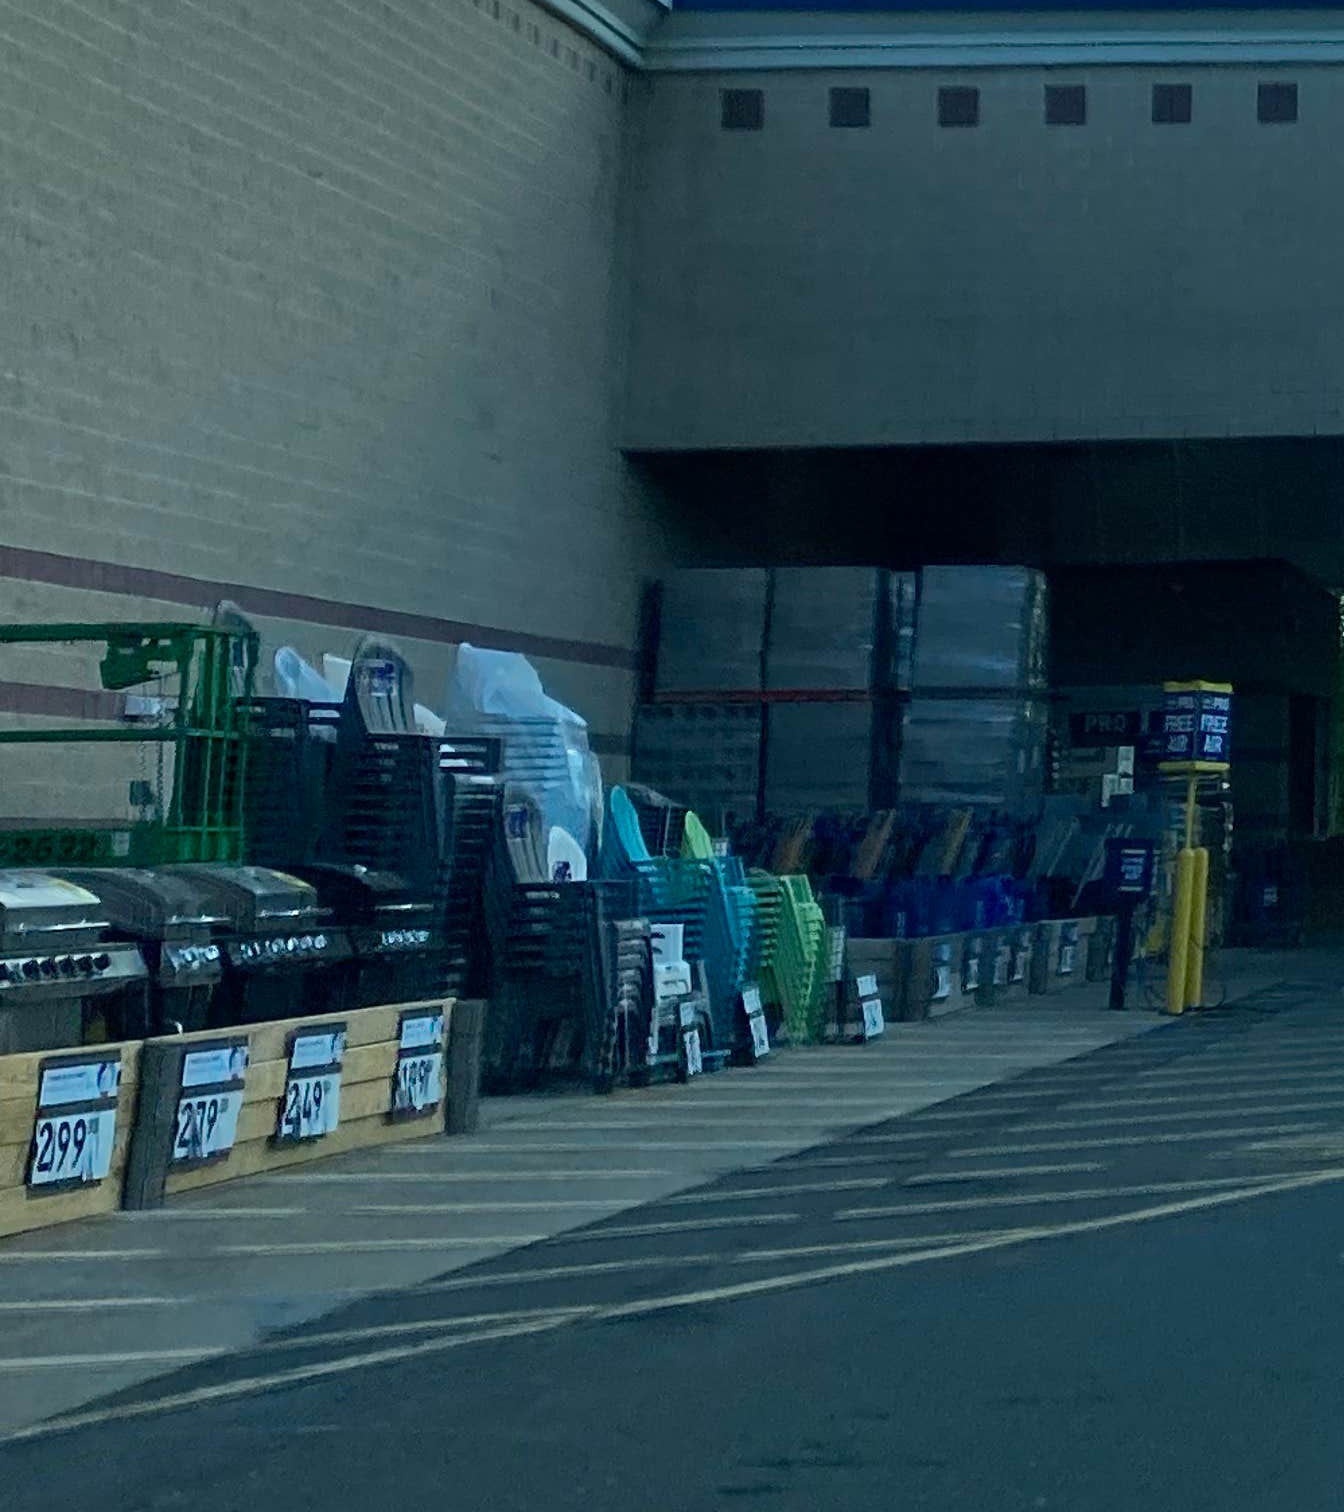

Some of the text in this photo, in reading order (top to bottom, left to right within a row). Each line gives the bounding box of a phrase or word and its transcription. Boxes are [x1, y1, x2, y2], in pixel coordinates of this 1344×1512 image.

[1164, 714, 1194, 733] FREE
[1200, 713, 1229, 734] FREE
[1167, 733, 1188, 753] AIR
[1203, 733, 1223, 753] AIR
[284, 1080, 323, 1126] 249
[177, 1098, 219, 1149] 279
[36, 1118, 87, 1173] 299
